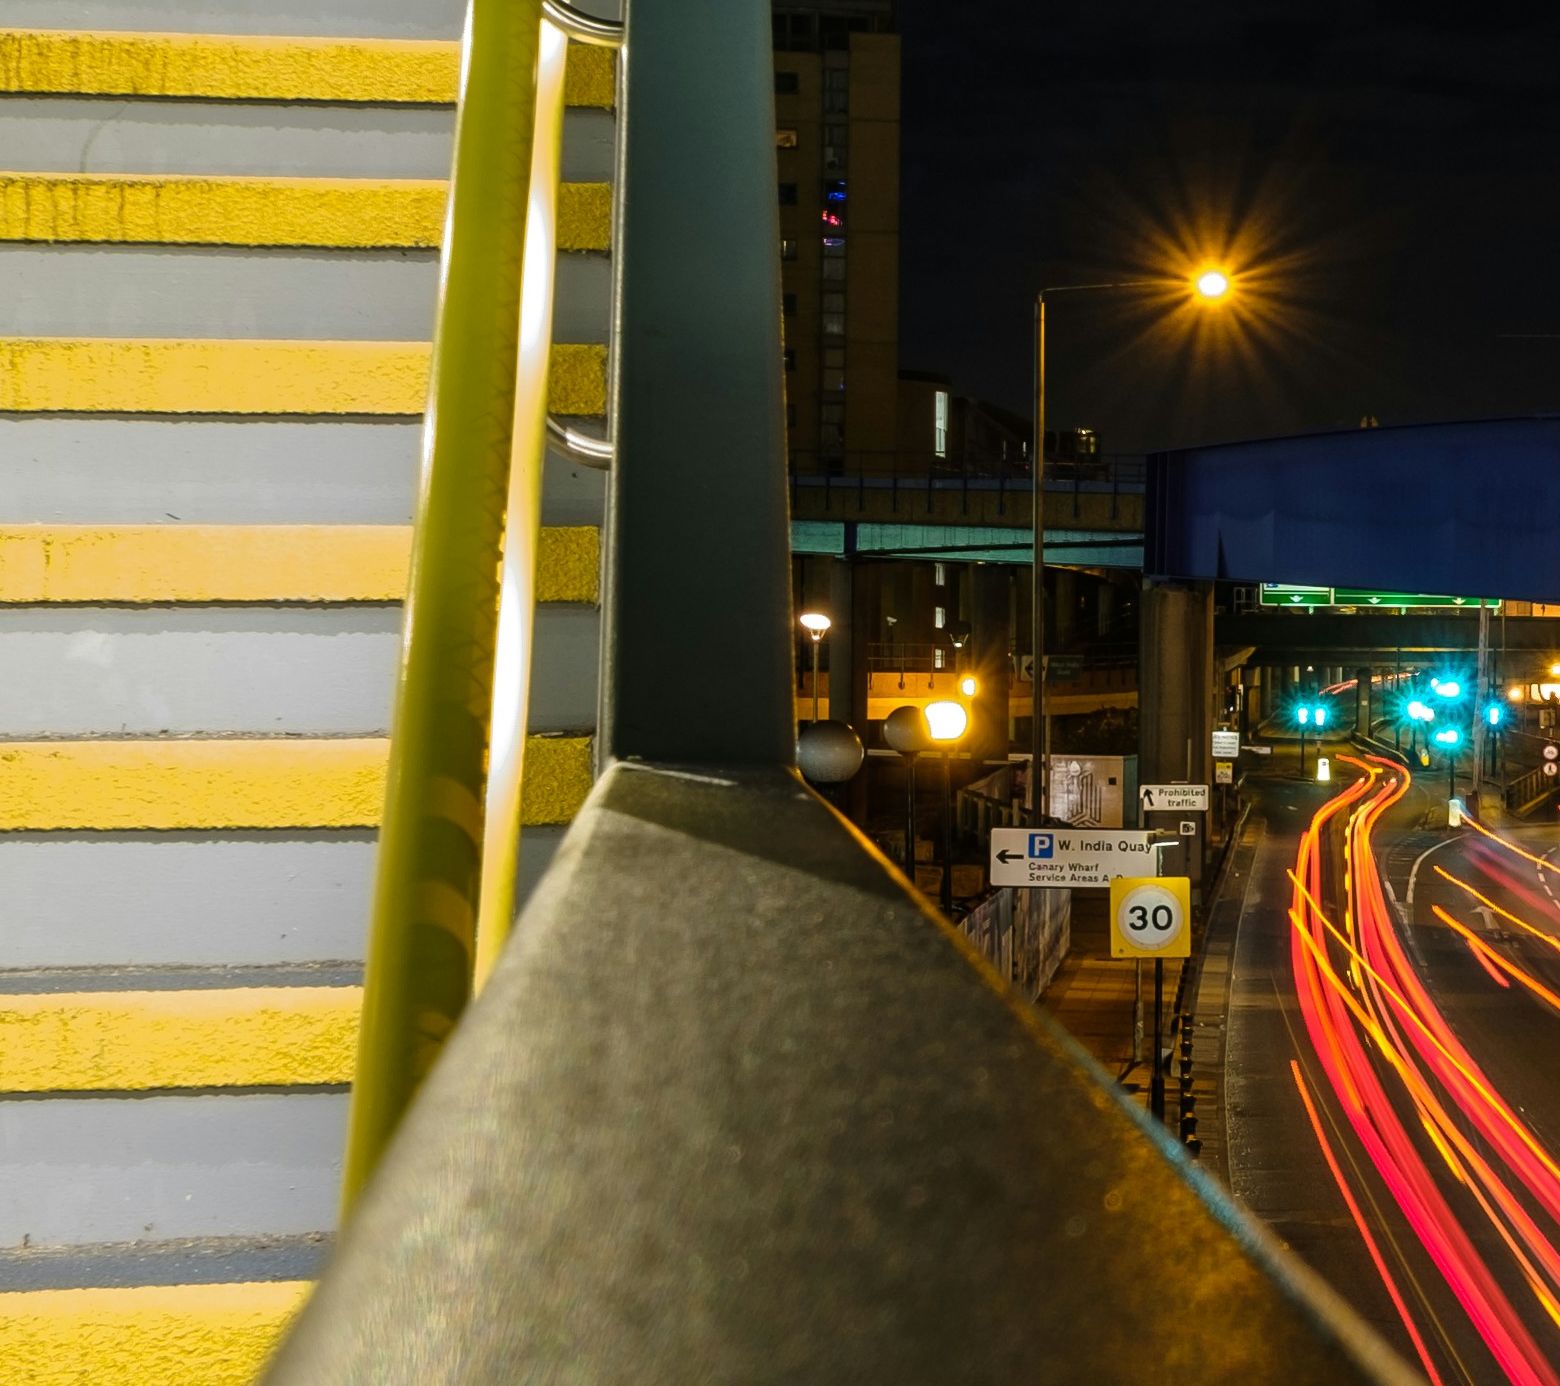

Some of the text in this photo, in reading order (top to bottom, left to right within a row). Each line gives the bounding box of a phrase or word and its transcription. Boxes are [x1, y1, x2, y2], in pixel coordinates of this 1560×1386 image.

[1159, 788, 1206, 797] Prohibited
[1168, 799, 1197, 807] traffic
[1034, 836, 1153, 857] P W. India Quay
[1028, 862, 1100, 873] Canary Wharf
[1028, 873, 1066, 883] Service
[1069, 874, 1099, 883] Areas
[1128, 904, 1174, 932] 30
